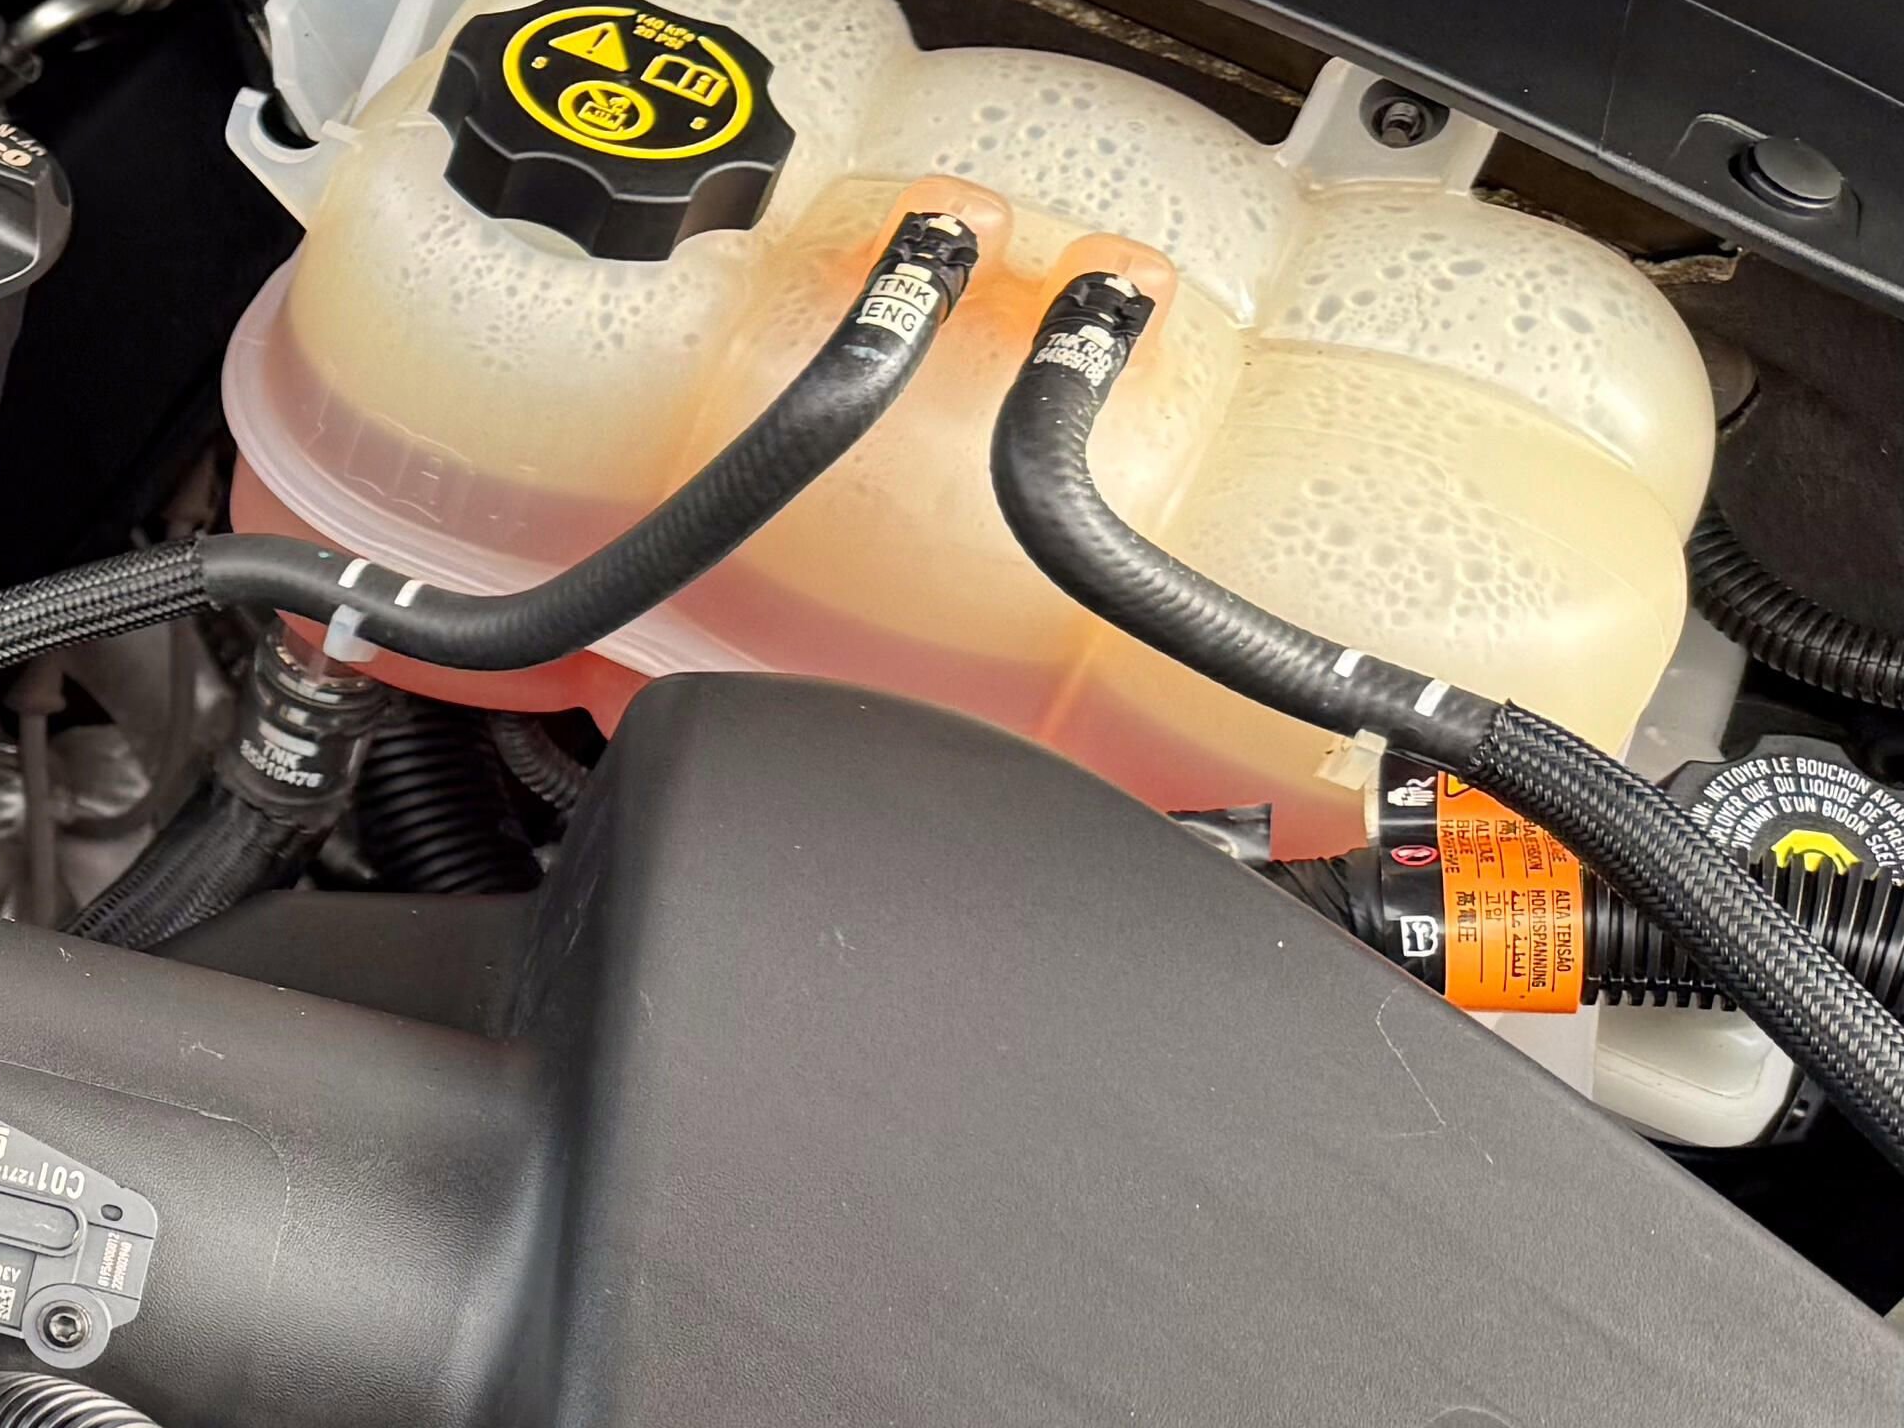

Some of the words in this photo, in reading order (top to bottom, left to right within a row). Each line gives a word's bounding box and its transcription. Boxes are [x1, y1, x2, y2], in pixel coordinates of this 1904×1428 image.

[878, 277, 932, 307] TNK
[864, 301, 918, 333] ENG
[262, 738, 304, 770] TNK
[1703, 758, 1771, 802] NETTOYER
[1772, 756, 1793, 775] LE
[1796, 756, 1872, 795] BOUCHON
[1741, 777, 1773, 803] QUE
[1800, 776, 1861, 809] LIQUIDE
[1858, 801, 1883, 823] DE
[1779, 794, 1817, 814] D'UN
[1821, 800, 1870, 836] BIDON
[1485, 890, 1503, 922] 고압
[1555, 889, 1572, 920] ALTA
[1530, 889, 1548, 989] HOCHSPANNUNG
[1556, 923, 1576, 973] TENSÃO
[37, 1161, 86, 1200] C01
